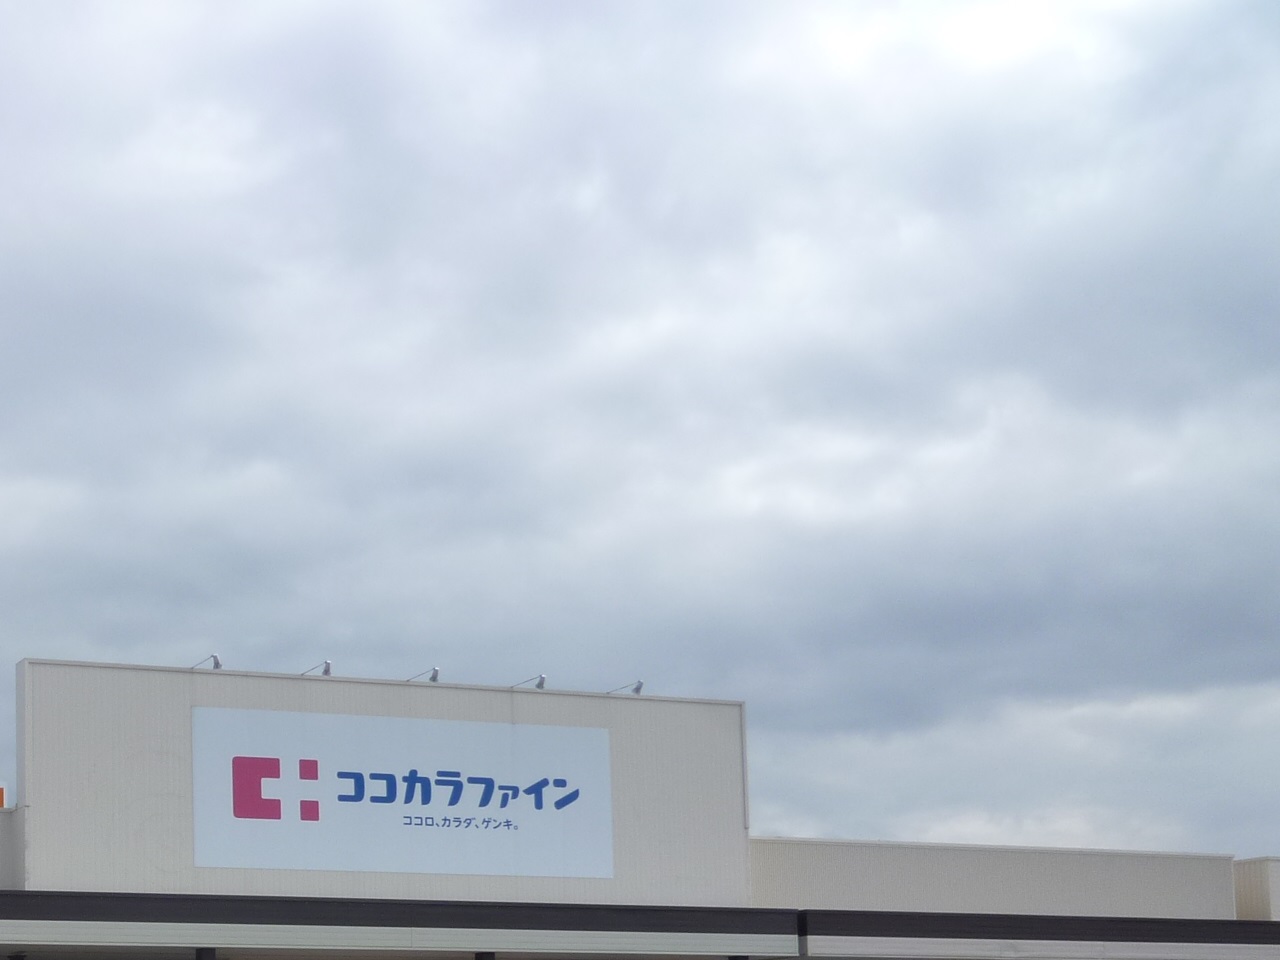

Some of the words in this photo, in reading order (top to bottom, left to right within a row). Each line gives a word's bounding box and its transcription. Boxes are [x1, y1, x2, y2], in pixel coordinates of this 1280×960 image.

[336, 769, 580, 811] ココカラファイン
